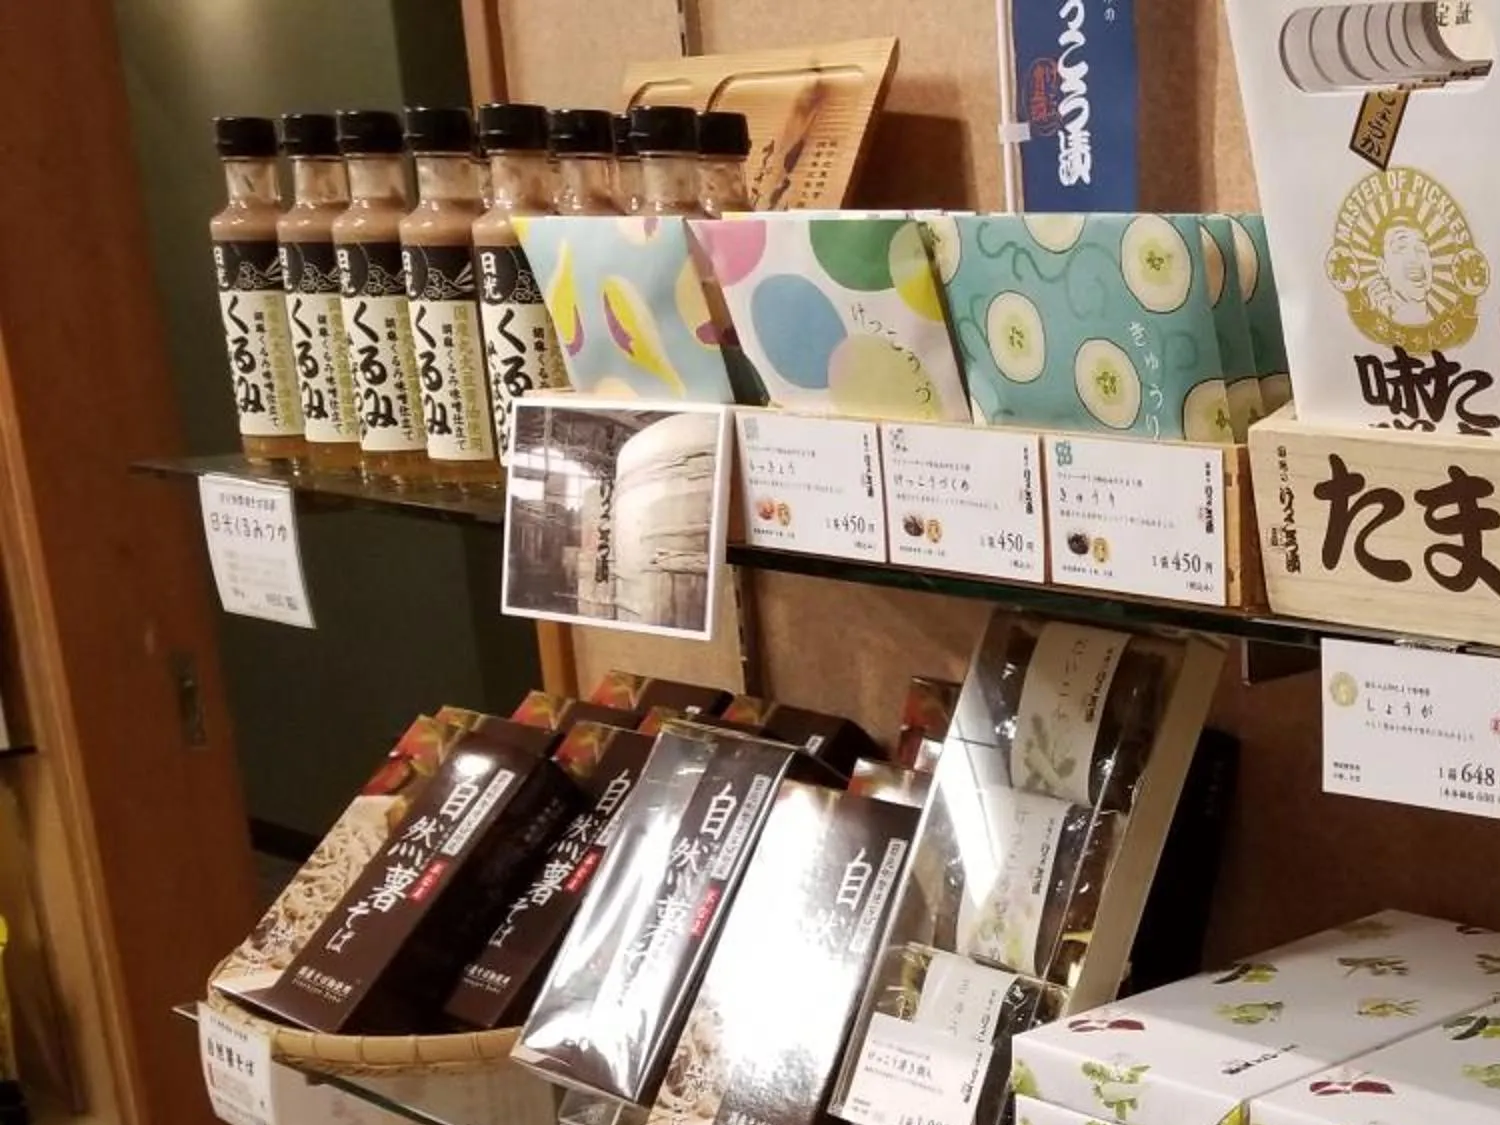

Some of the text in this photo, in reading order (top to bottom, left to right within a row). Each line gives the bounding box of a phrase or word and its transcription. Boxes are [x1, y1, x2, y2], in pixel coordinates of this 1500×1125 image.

[1336, 170, 1470, 243] MASTER OF PICKLES
[480, 252, 502, 299] 日光
[227, 295, 266, 414] くるみ
[291, 297, 330, 421] くるみ
[353, 302, 398, 429] くるみ
[415, 305, 453, 437] くるみ
[325, 774, 478, 956] 自然薯そば
